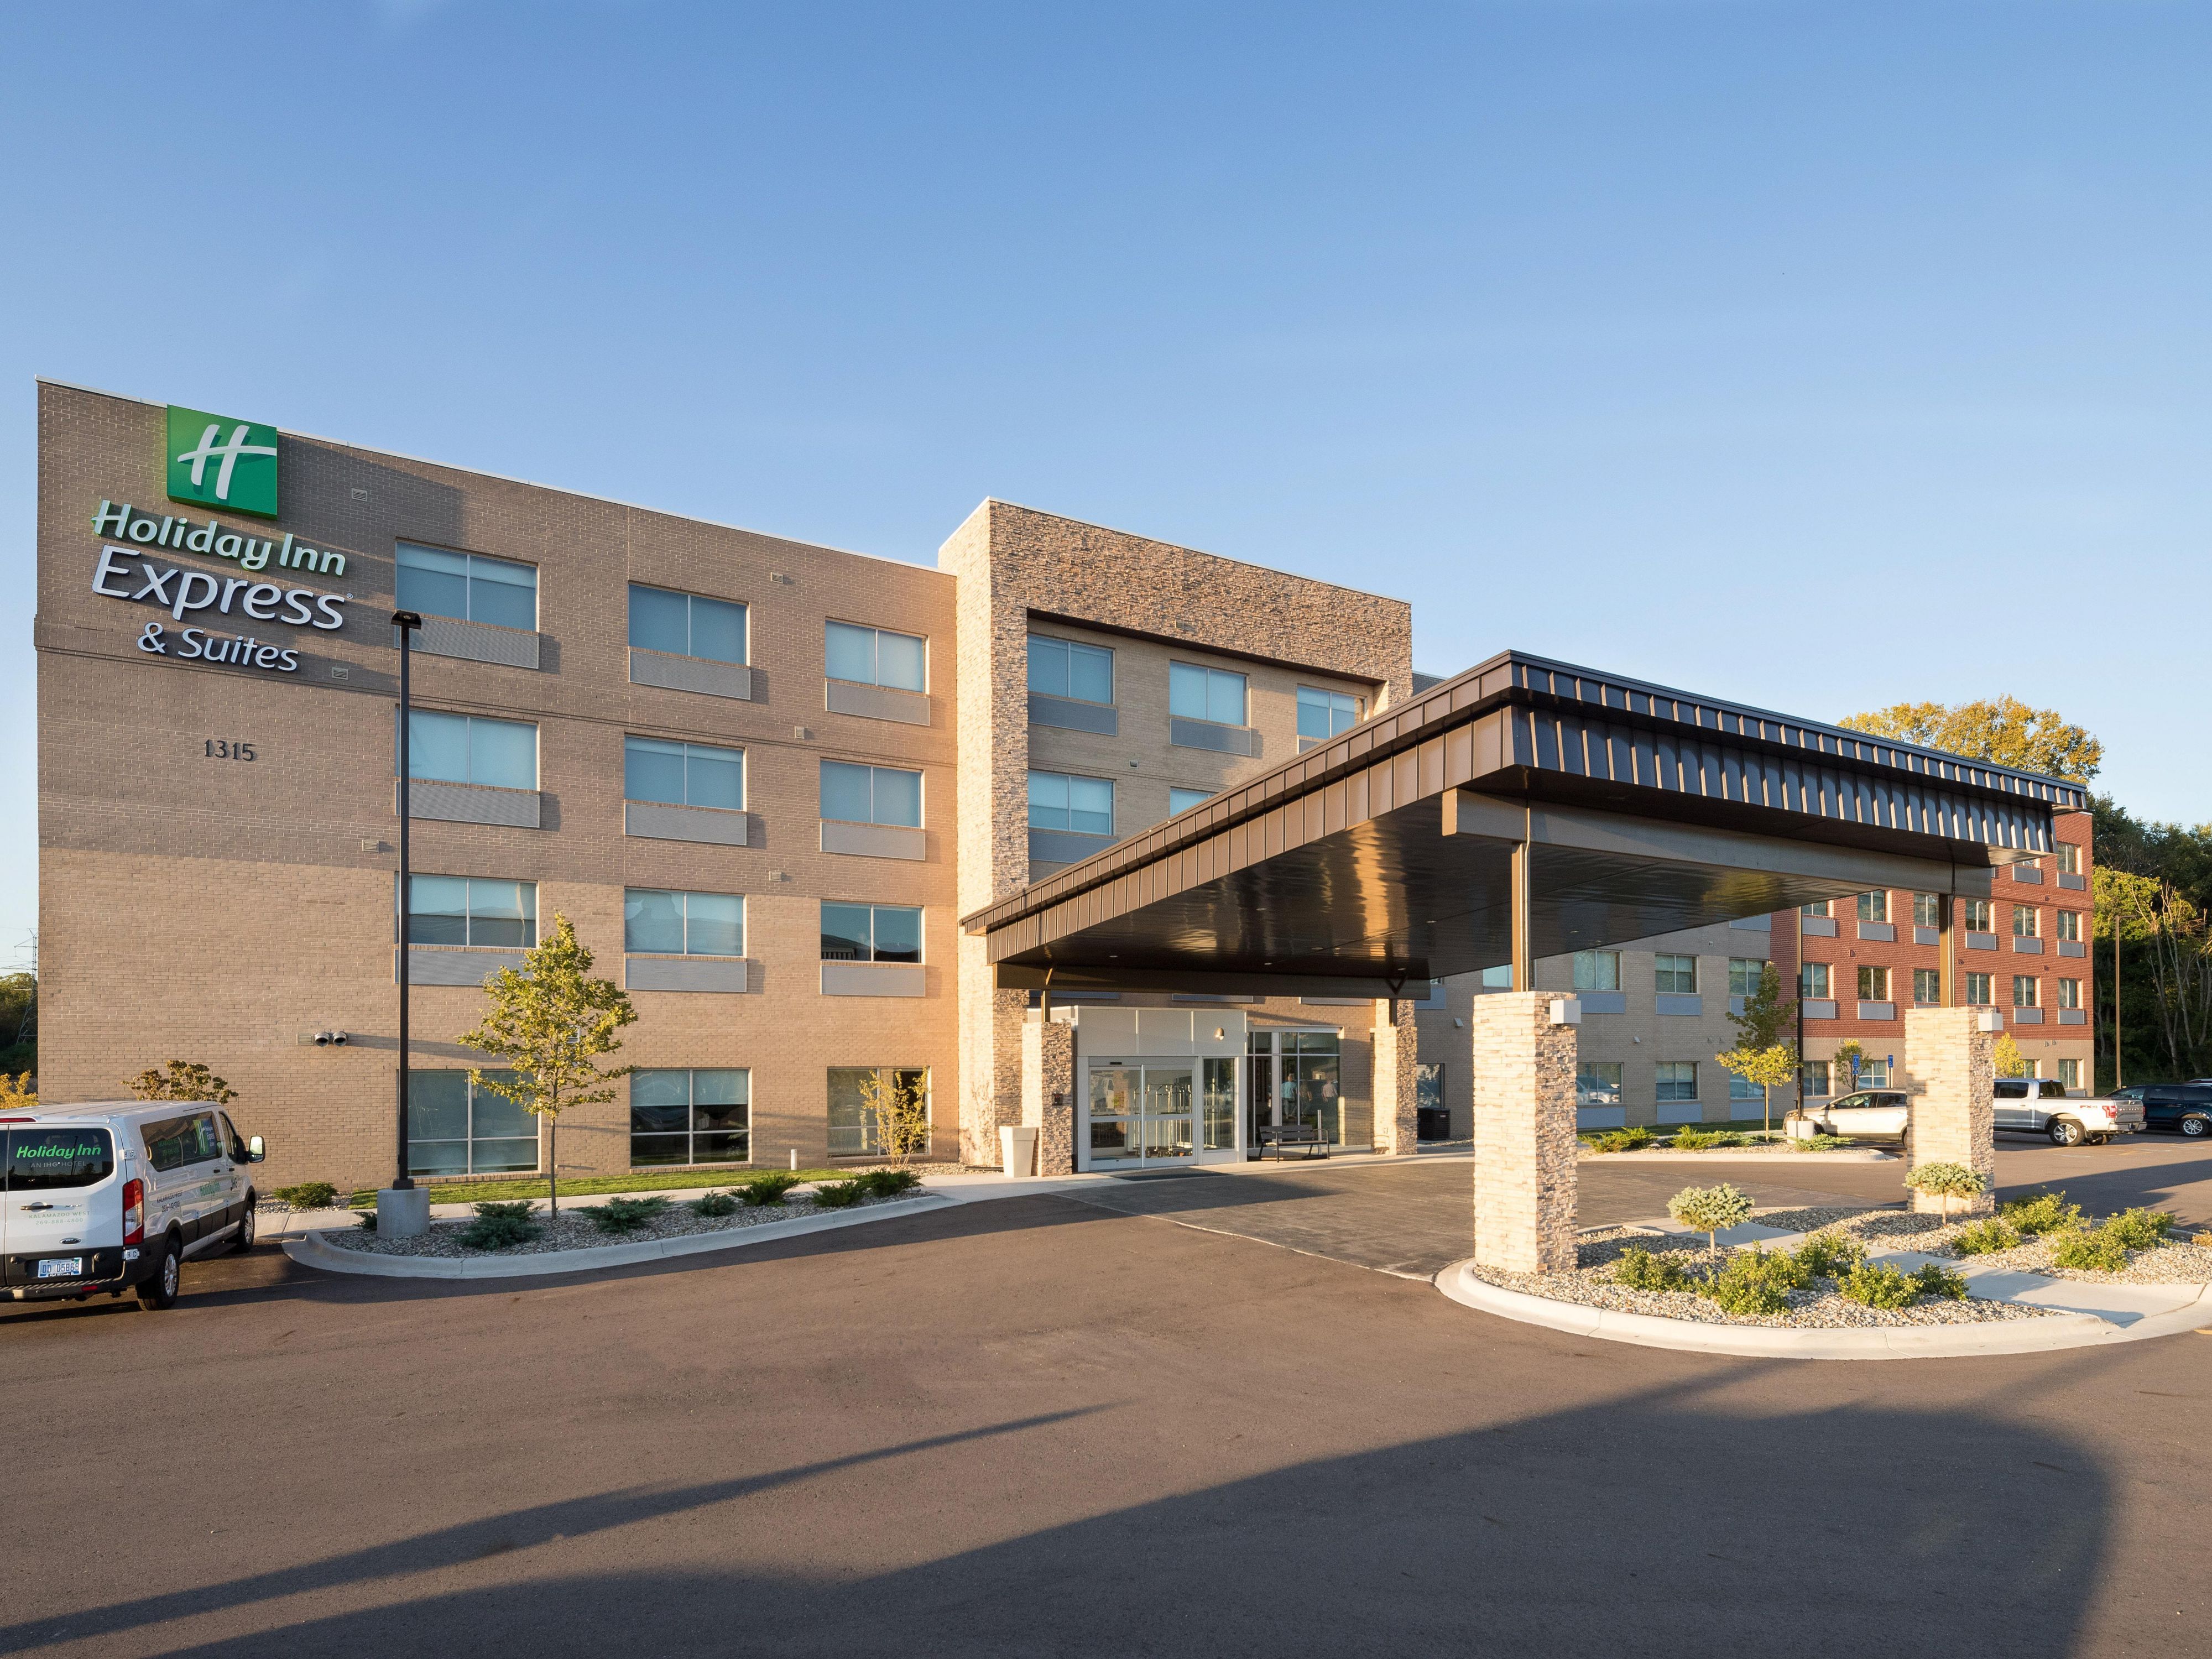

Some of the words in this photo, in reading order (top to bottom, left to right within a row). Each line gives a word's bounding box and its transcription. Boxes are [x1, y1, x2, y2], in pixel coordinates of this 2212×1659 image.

[91, 499, 273, 571] Holiday
[279, 533, 347, 577] Inn
[137, 622, 166, 654] &
[178, 628, 299, 672] Suites
[204, 739, 255, 761] 1315
[16, 1145, 75, 1159] Holiday
[77, 1144, 101, 1156] Inn
